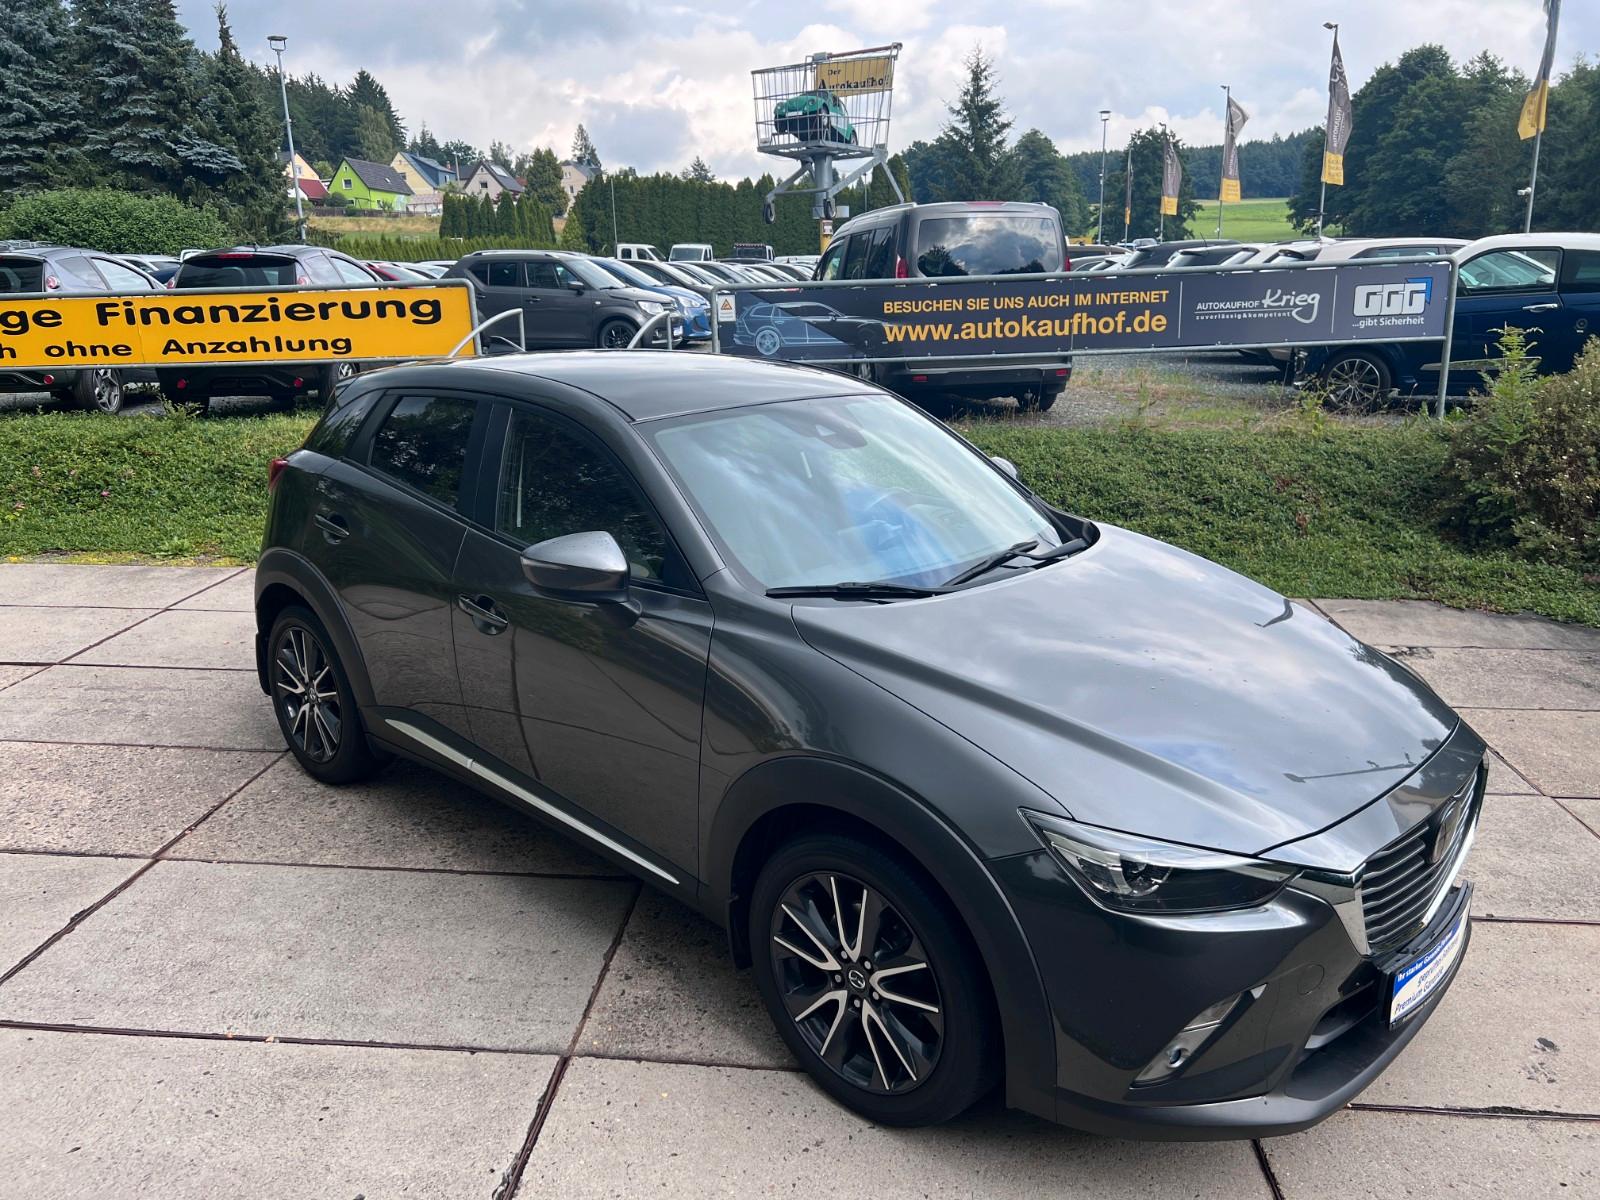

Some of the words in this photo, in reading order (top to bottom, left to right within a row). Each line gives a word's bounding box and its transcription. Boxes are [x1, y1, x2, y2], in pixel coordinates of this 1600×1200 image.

[96, 297, 442, 326] Finanzierung
[883, 299, 963, 314] BESUCHEN
[966, 297, 990, 311] SIE
[993, 296, 1025, 310] UNS
[1027, 294, 1070, 309] AUCH
[1074, 293, 1092, 306] IM
[1096, 290, 1170, 305] INTERNET
[1196, 300, 1261, 311] AUTOKAUFHOF
[1261, 288, 1321, 324] Krieg
[884, 310, 1167, 341] www.autokaufhof.de
[1379, 315, 1425, 326] Sicherheit
[44, 340, 133, 357] ohne
[162, 335, 353, 355] Anzahlung
